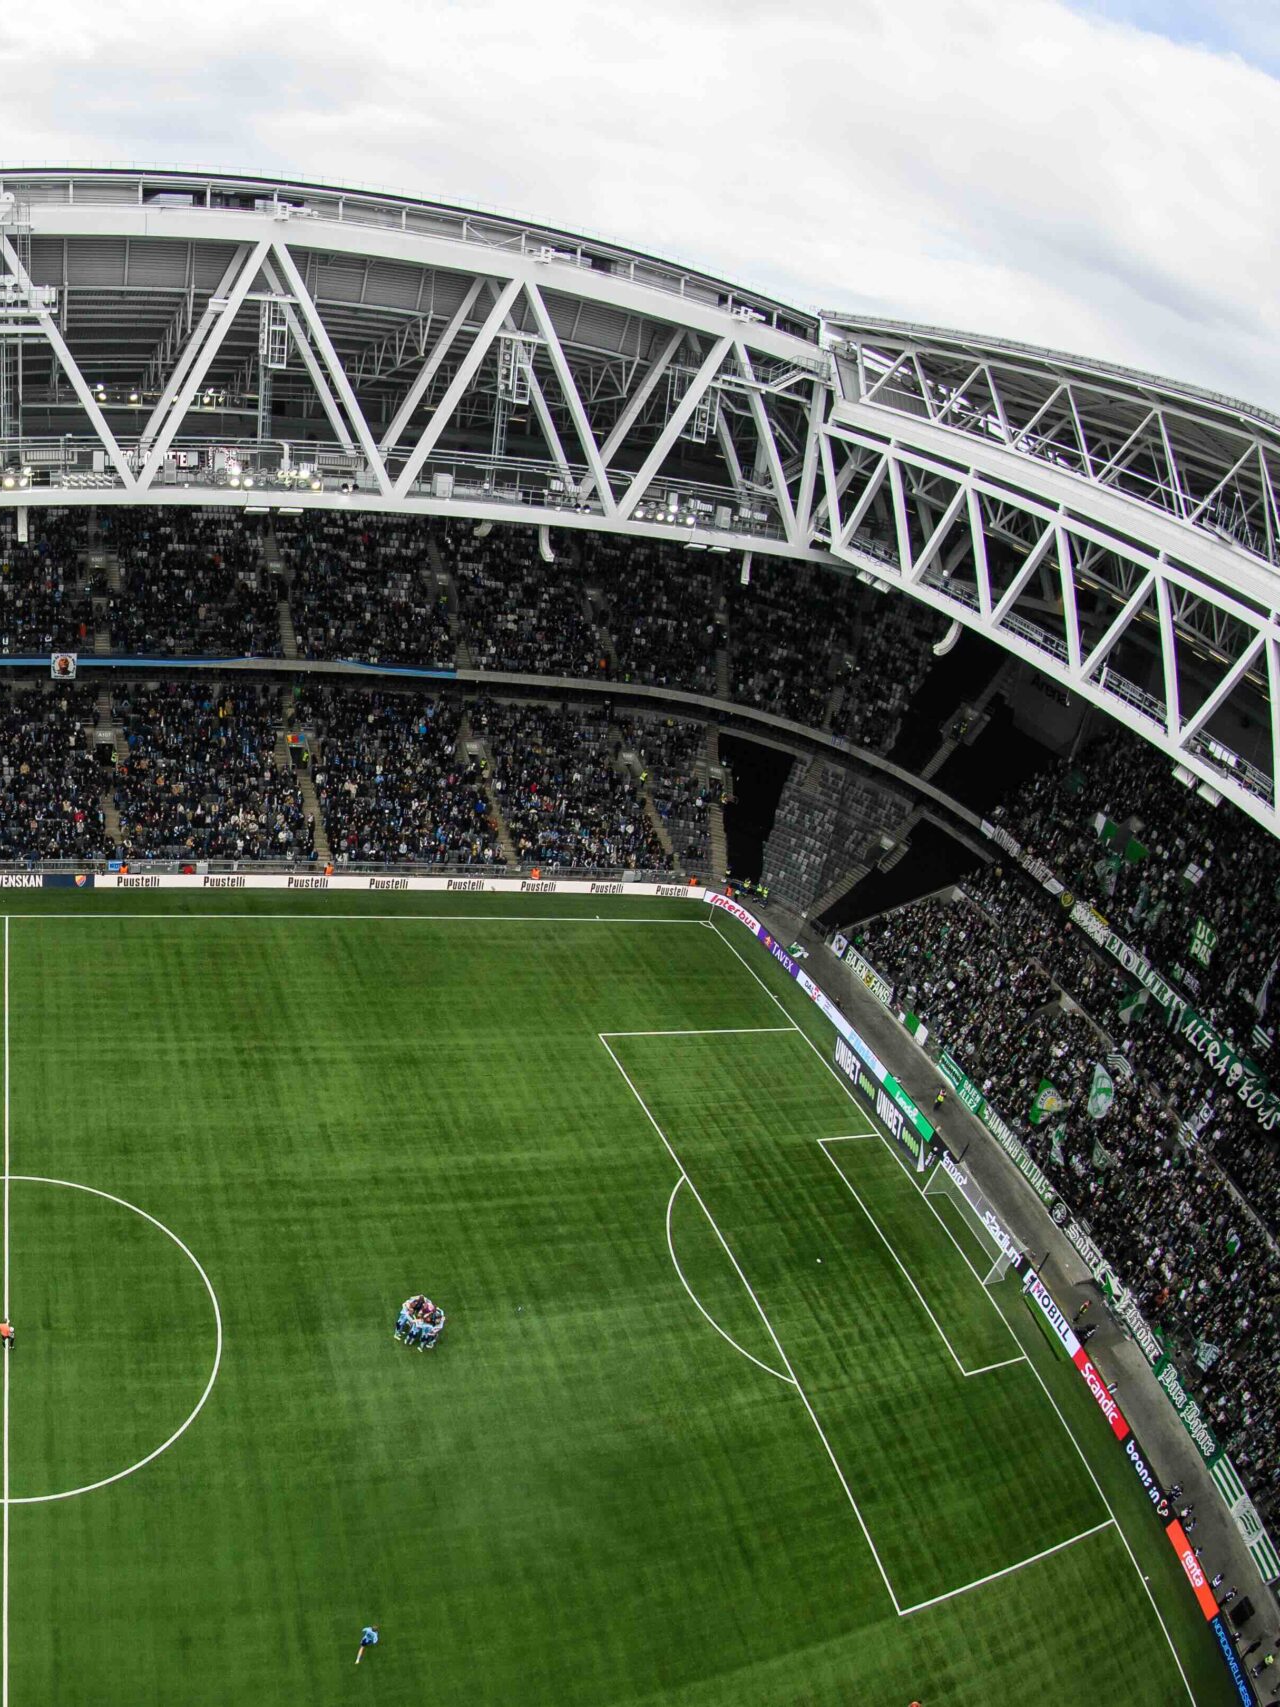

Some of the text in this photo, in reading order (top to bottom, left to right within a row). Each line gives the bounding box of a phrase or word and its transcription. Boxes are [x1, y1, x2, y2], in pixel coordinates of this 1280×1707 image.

[117, 875, 160, 888] Puustelli
[203, 875, 245, 888] Puustelli
[288, 876, 328, 888] Puustelli
[369, 878, 409, 890] Puustelli
[447, 879, 484, 891] Puustelli
[521, 881, 556, 893] Puustelli
[590, 883, 624, 895] Puustelli
[656, 885, 689, 897] Puustelli
[710, 894, 757, 930] Interbus
[770, 944, 794, 973] TAVEX
[845, 950, 889, 1005] BAJEN FANS
[835, 1036, 861, 1085] UNIBET
[876, 1088, 903, 1140] UNIBET
[981, 1210, 1023, 1268] stadium
[1031, 1281, 1071, 1343] MOBILL
[1081, 1362, 1119, 1425] Scandic
[1126, 1439, 1152, 1487] beans
[1148, 1486, 1159, 1504] in
[1182, 1550, 1203, 1588] renta
